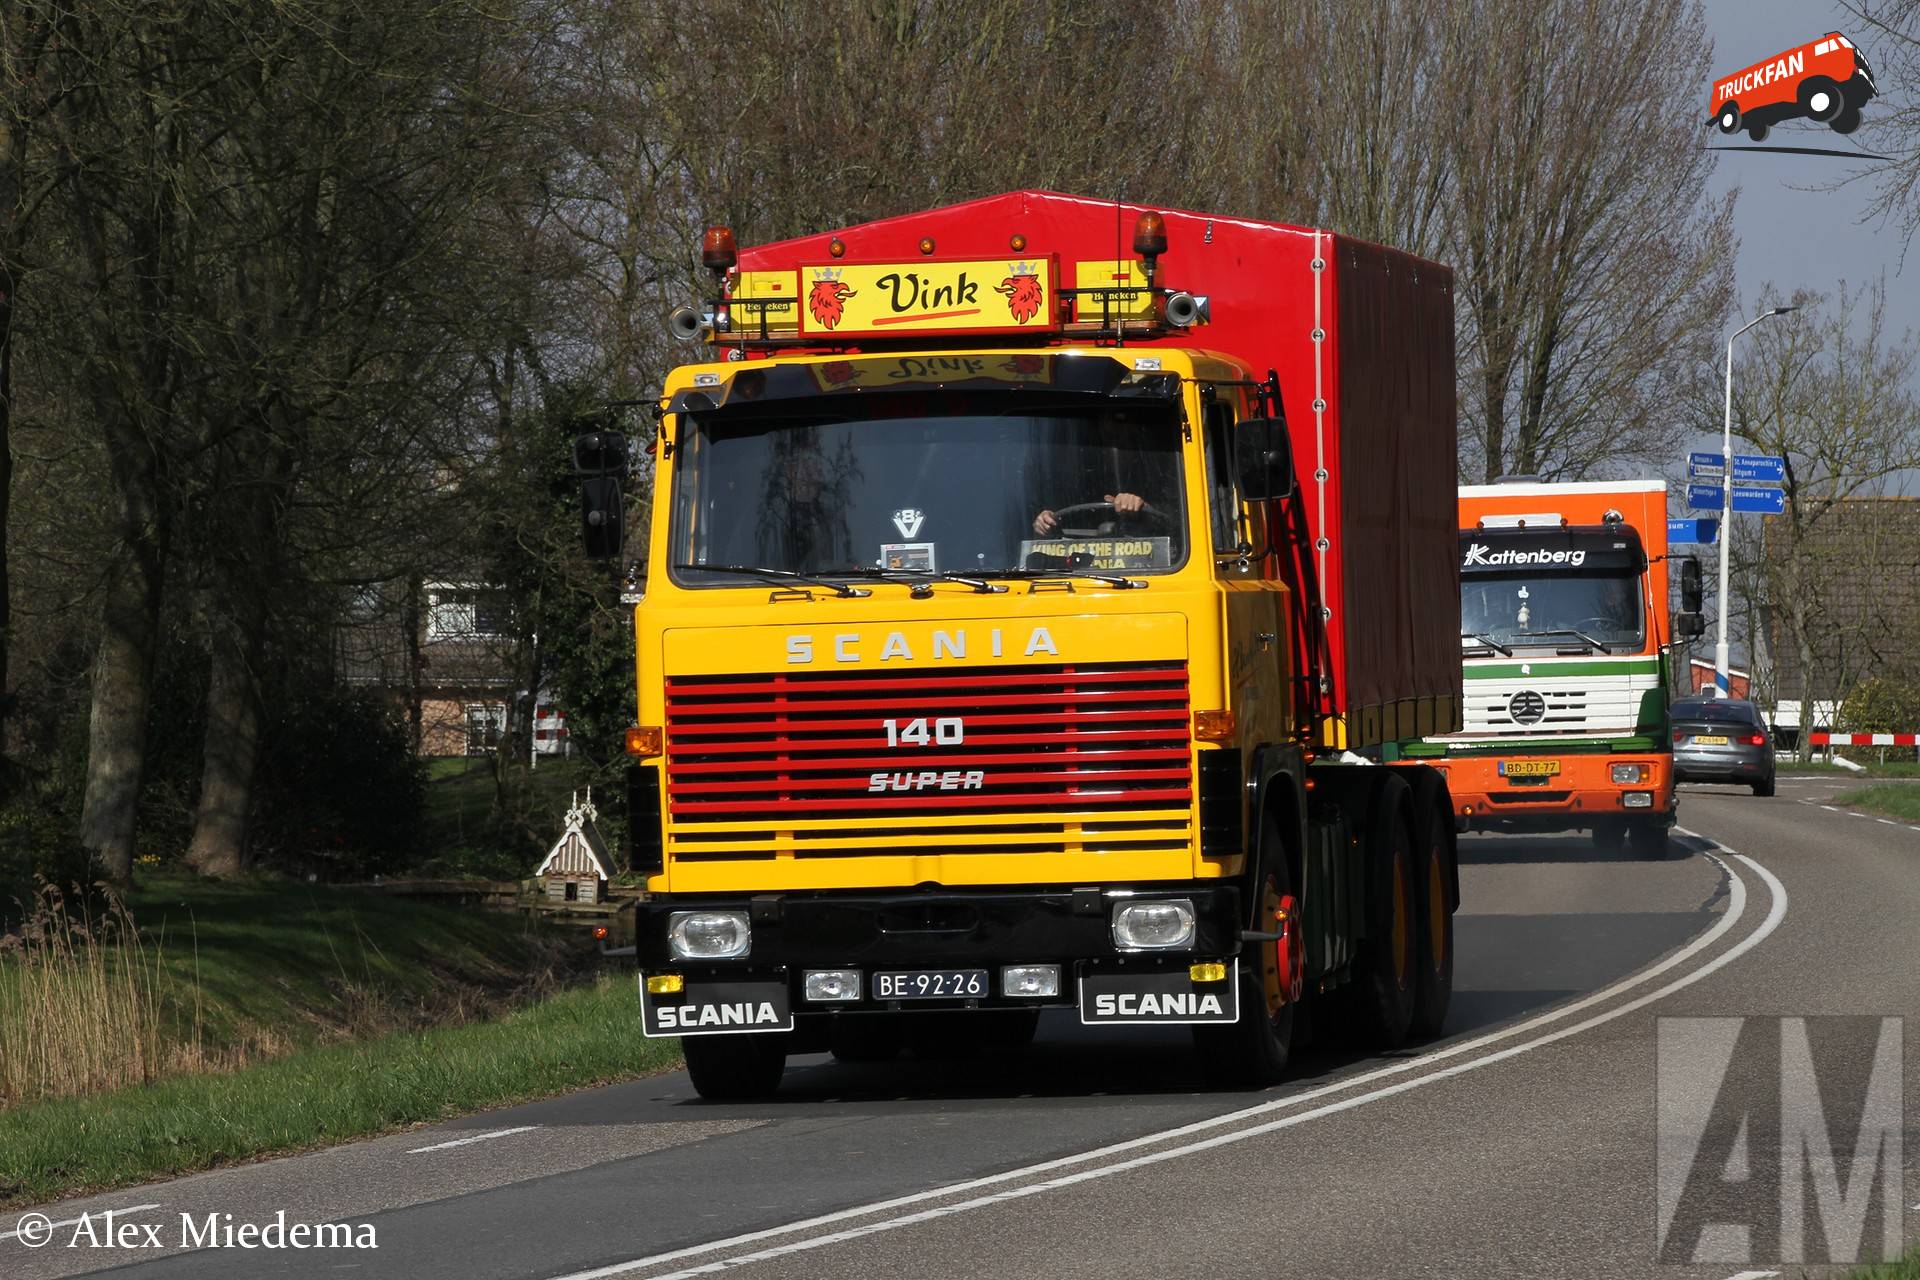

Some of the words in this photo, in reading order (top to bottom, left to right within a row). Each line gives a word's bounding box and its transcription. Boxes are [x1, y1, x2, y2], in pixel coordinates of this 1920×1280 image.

[876, 272, 978, 312] Vink
[1033, 544, 1066, 556] KING
[1088, 542, 1112, 556] THE
[1115, 541, 1153, 556] ROAD
[1463, 543, 1586, 566] Kattenberg
[787, 628, 1058, 663] SCANIA
[882, 717, 964, 747] 140
[1507, 762, 1557, 773] BD-DT-77
[868, 771, 984, 792] SUPER
[880, 974, 980, 996] BE-92-26
[657, 1002, 779, 1029] SCANIA
[1095, 992, 1223, 1017] SCANIA
